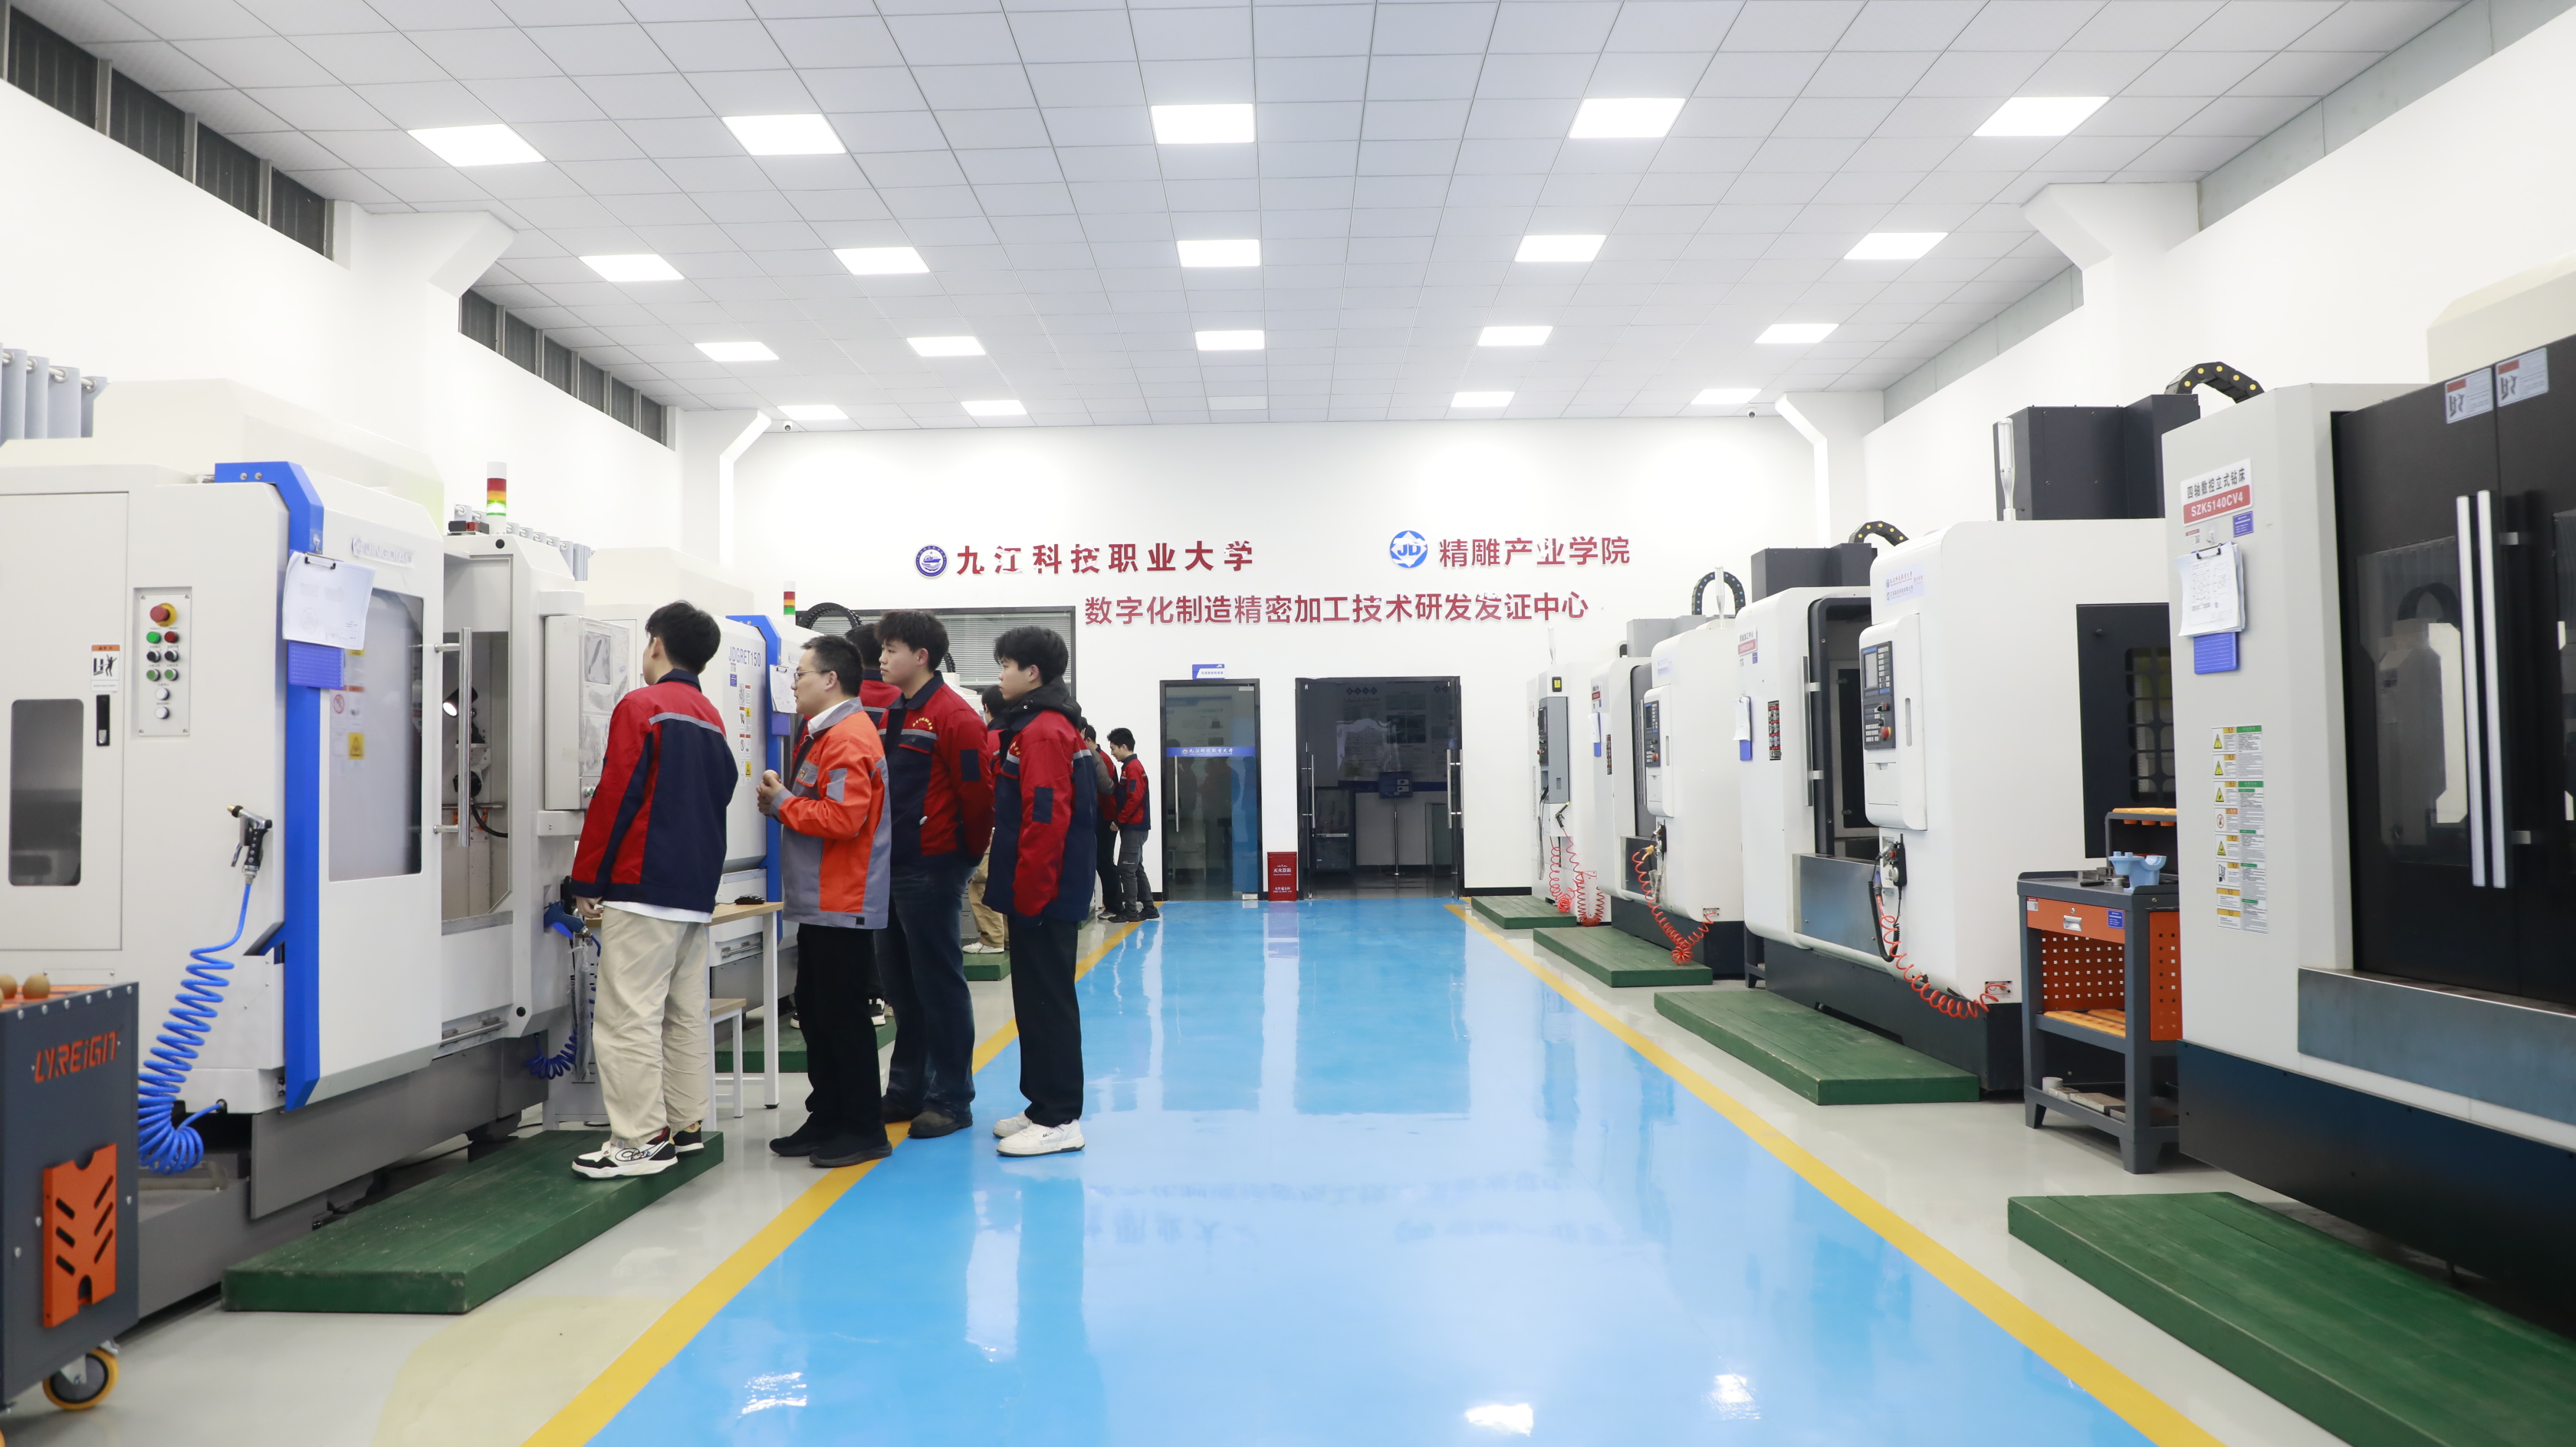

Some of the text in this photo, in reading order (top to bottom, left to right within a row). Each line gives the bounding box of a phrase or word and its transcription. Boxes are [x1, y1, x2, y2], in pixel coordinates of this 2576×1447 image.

[2187, 467, 2246, 499] 四轴数控立式钻床
[2191, 491, 2244, 517] SZK5140CV4
[956, 540, 1254, 576] 九江科技职业大学
[1397, 543, 1421, 556] JD
[1438, 536, 1631, 568] 精雕产业学院
[1084, 590, 1589, 625] 数字化制造精密加工技术研发发证中心
[728, 646, 761, 667] JDGRET150
